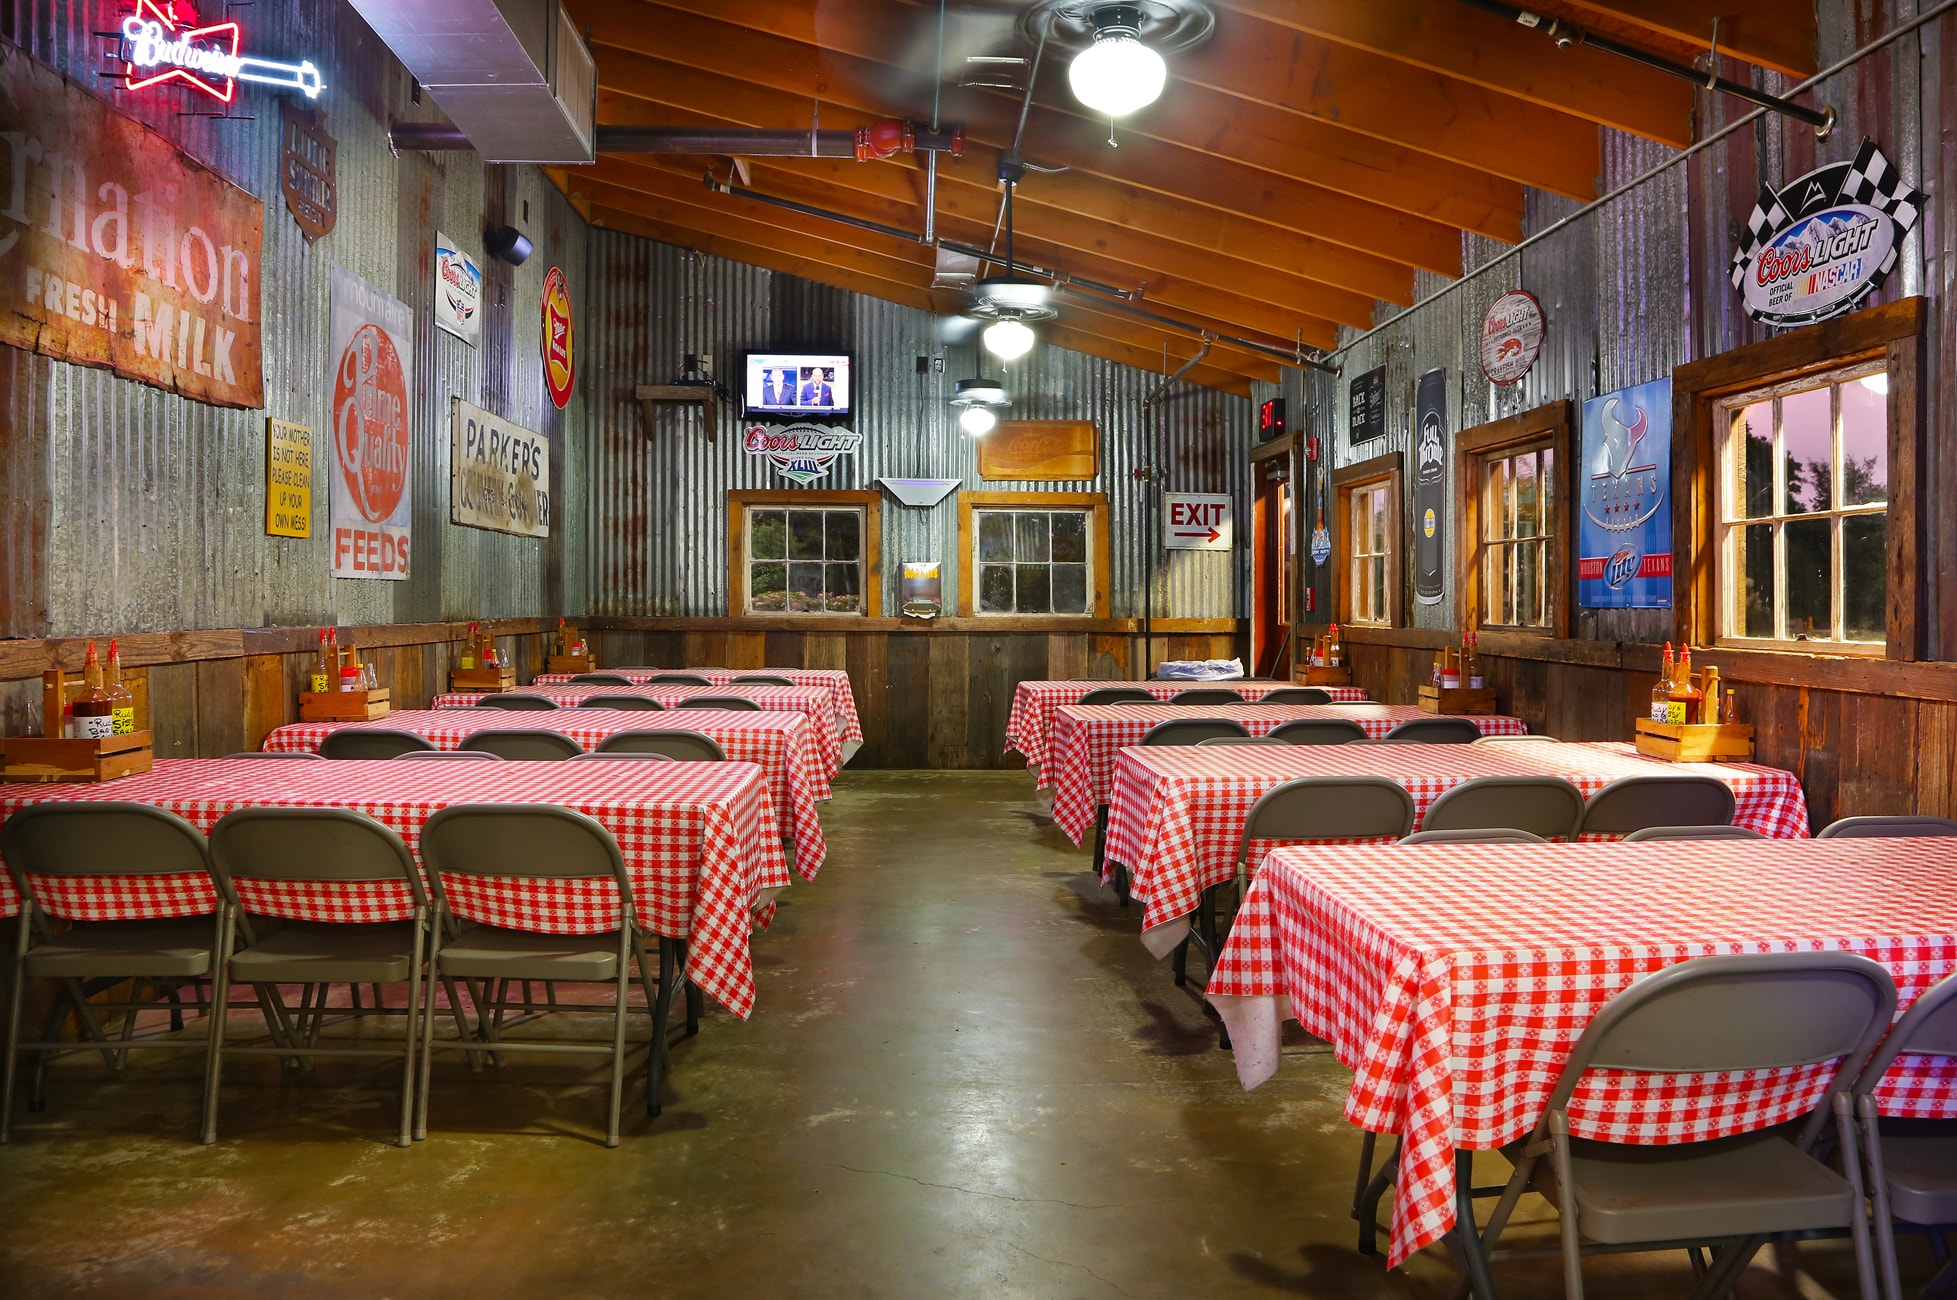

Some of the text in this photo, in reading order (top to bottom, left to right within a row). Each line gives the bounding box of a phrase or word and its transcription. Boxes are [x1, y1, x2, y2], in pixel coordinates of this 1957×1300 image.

[291, 121, 331, 176] LONE
[288, 158, 333, 212] STAR
[0, 130, 253, 323] rnation
[1758, 219, 1878, 287] Coors LIGHT
[441, 258, 461, 289] Coors
[459, 274, 478, 299] LIGHT
[1813, 256, 1863, 292] NASCAR
[1768, 293, 1793, 307] BEER OF
[1769, 281, 1793, 297] OFFICIAL
[26, 265, 237, 386] FRESH MILK
[1506, 305, 1530, 329] LIGHT
[343, 328, 401, 428] Prime
[272, 423, 311, 447] YOUR MOTHER
[745, 428, 858, 451] Coors LIGHT
[273, 445, 280, 462] IS
[282, 448, 294, 464] NOT
[339, 396, 406, 519] Quality
[466, 418, 541, 481] PARKER'S
[272, 467, 310, 489] PLEASE CLEAN
[786, 459, 821, 474] XLIII
[280, 491, 303, 509] UP YOUR
[1591, 474, 1657, 503] TEXANS
[275, 512, 289, 529] OWN
[1171, 502, 1226, 526] EXIT
[334, 527, 410, 574] FEEDS
[1580, 561, 1603, 576] HOUSTON
[1643, 557, 1670, 573] TEXANS
